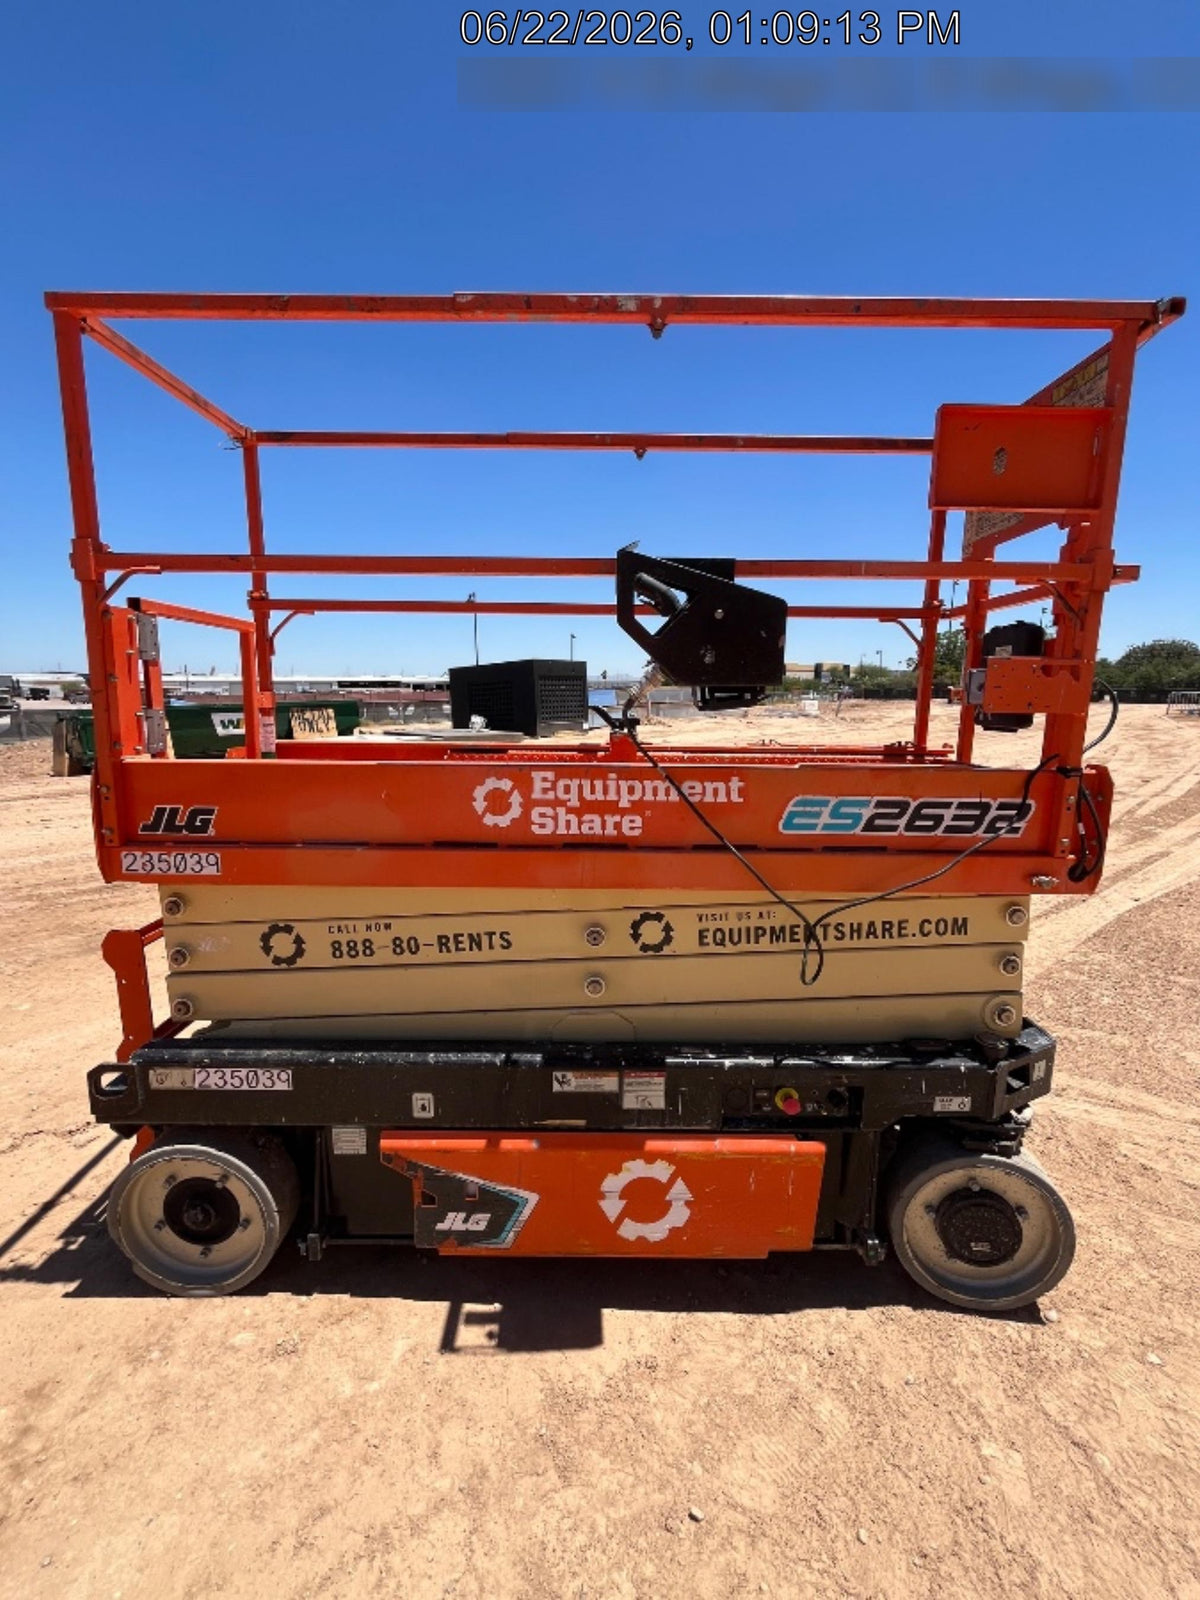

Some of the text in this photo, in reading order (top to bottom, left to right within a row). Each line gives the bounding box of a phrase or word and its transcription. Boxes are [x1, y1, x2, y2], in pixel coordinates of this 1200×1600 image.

[531, 771, 745, 807] Equipment
[139, 805, 218, 835] JLG
[531, 807, 643, 836] Share
[780, 796, 1035, 837] ES2632
[123, 853, 220, 874] 235039
[328, 922, 392, 934] CALL NOW
[697, 911, 776, 922] VISIT US AT:
[331, 931, 512, 959] 888-80-RENTS
[698, 917, 969, 948] EQUIPMENTSHARE.COM
[197, 1070, 292, 1089] 235039
[435, 1212, 491, 1231] JLG
